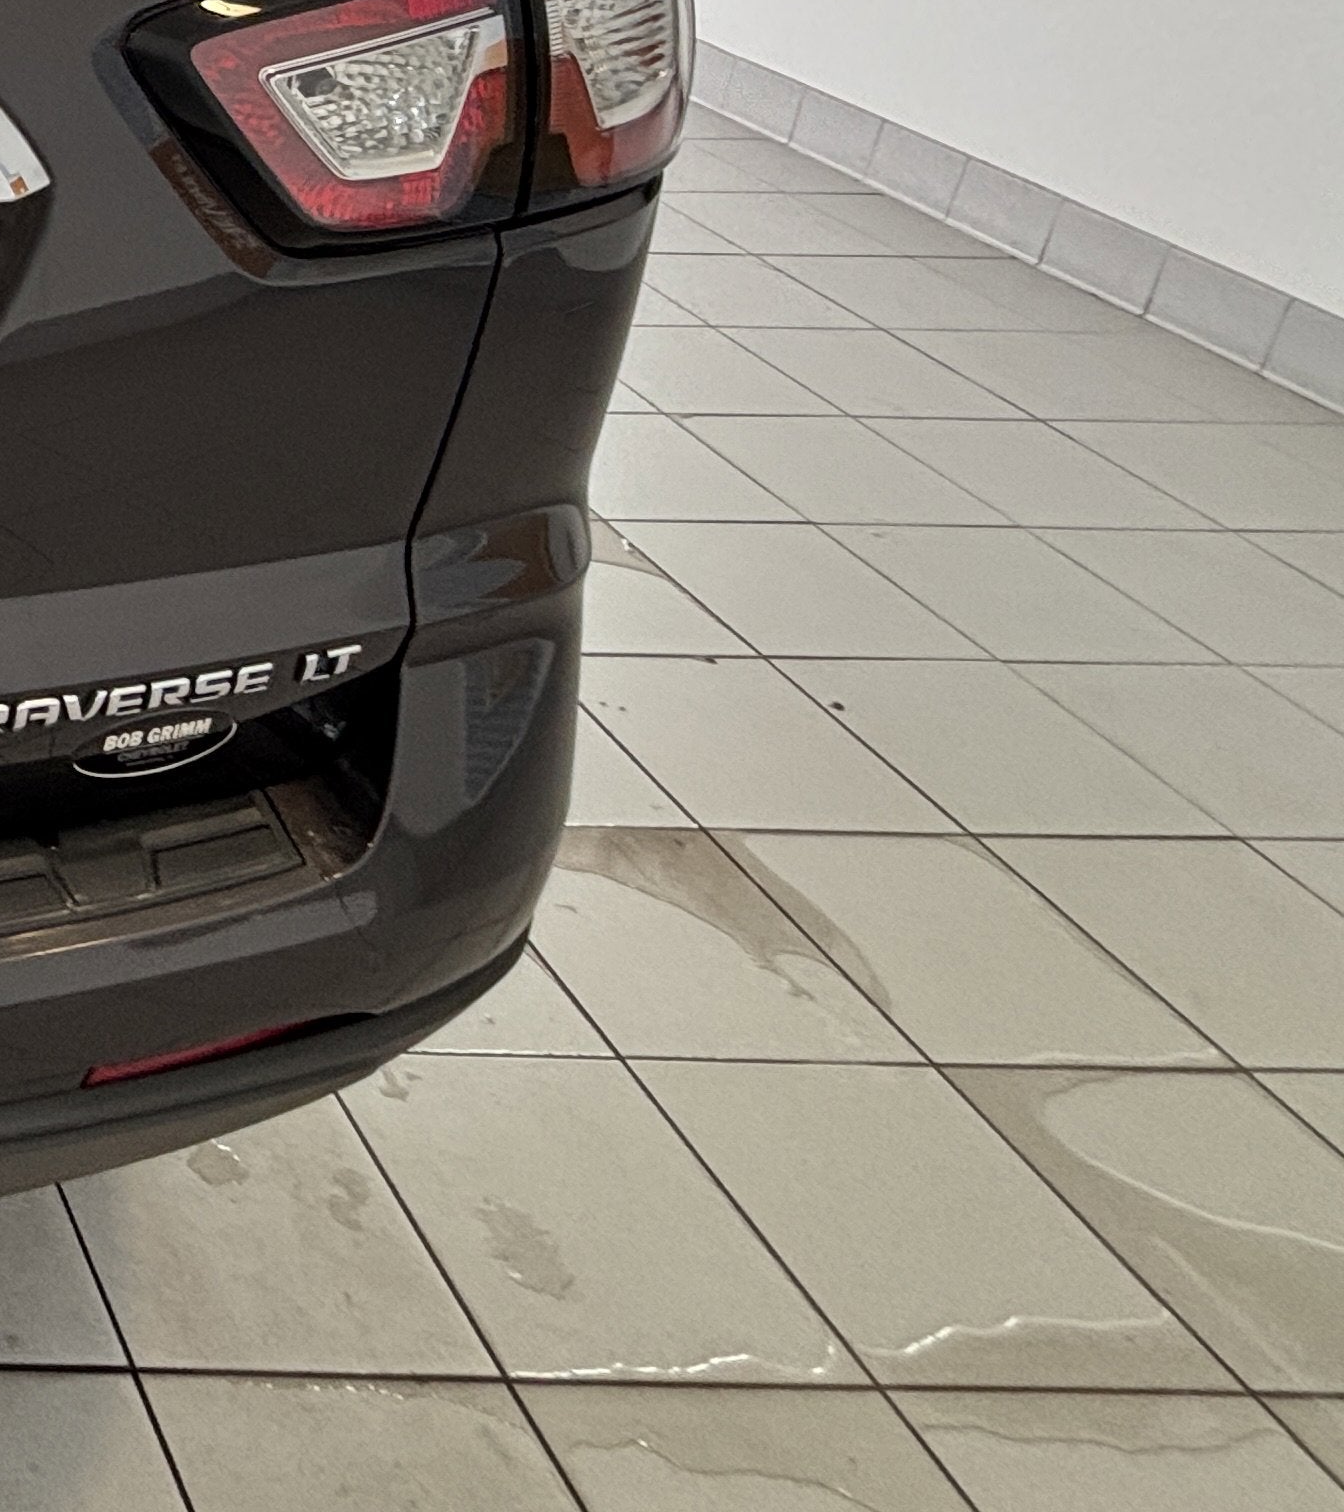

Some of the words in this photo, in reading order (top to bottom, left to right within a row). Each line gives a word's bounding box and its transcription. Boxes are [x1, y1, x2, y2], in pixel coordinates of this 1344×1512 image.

[300, 644, 362, 684] LT
[103, 730, 144, 752] BOB
[147, 717, 212, 744] GRIMM
